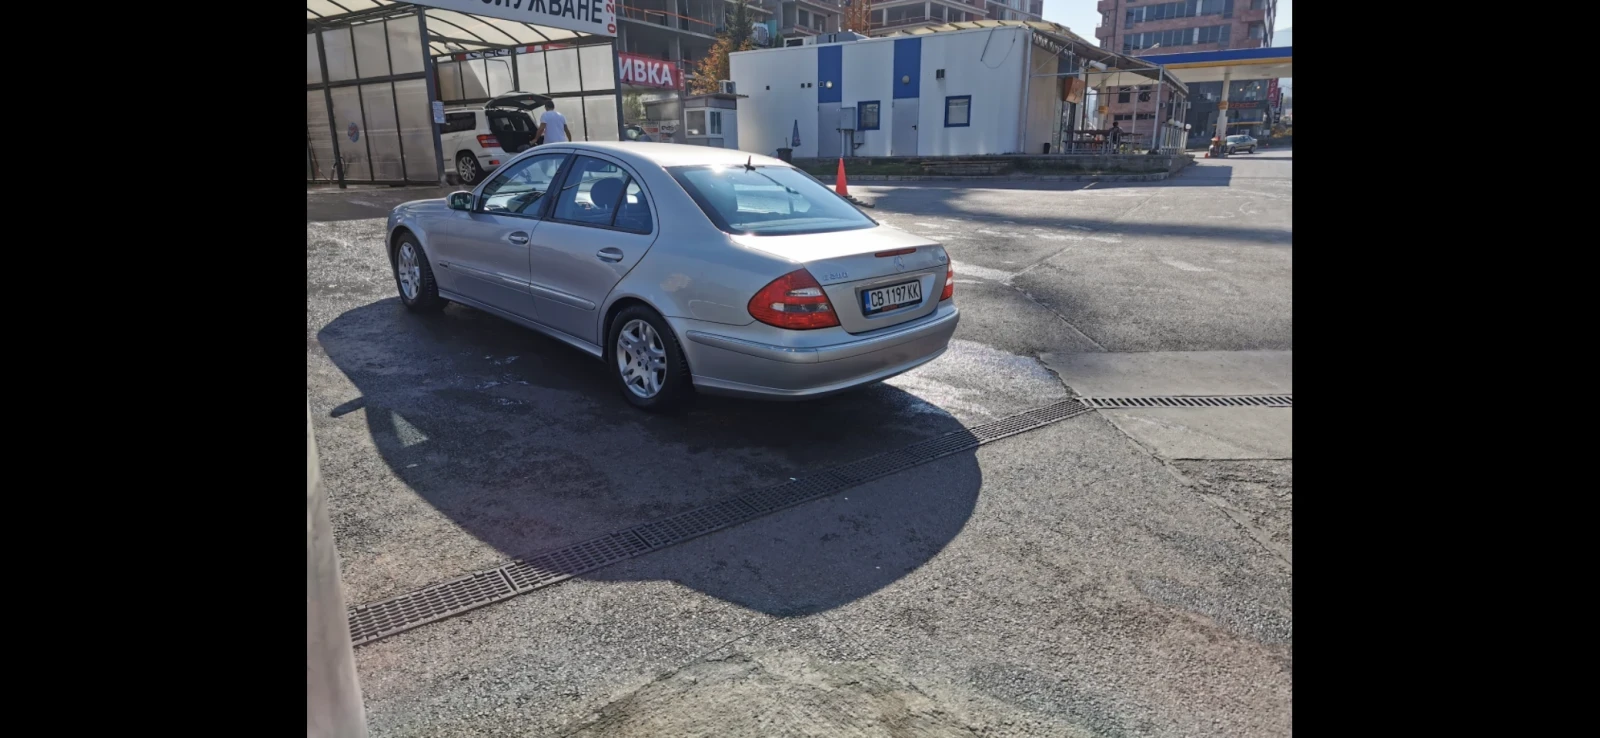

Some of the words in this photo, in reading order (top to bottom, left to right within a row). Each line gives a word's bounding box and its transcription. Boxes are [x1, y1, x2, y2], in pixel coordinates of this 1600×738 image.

[871, 290, 885, 307] CB
[886, 285, 906, 304] 1197
[907, 283, 920, 300] KK
